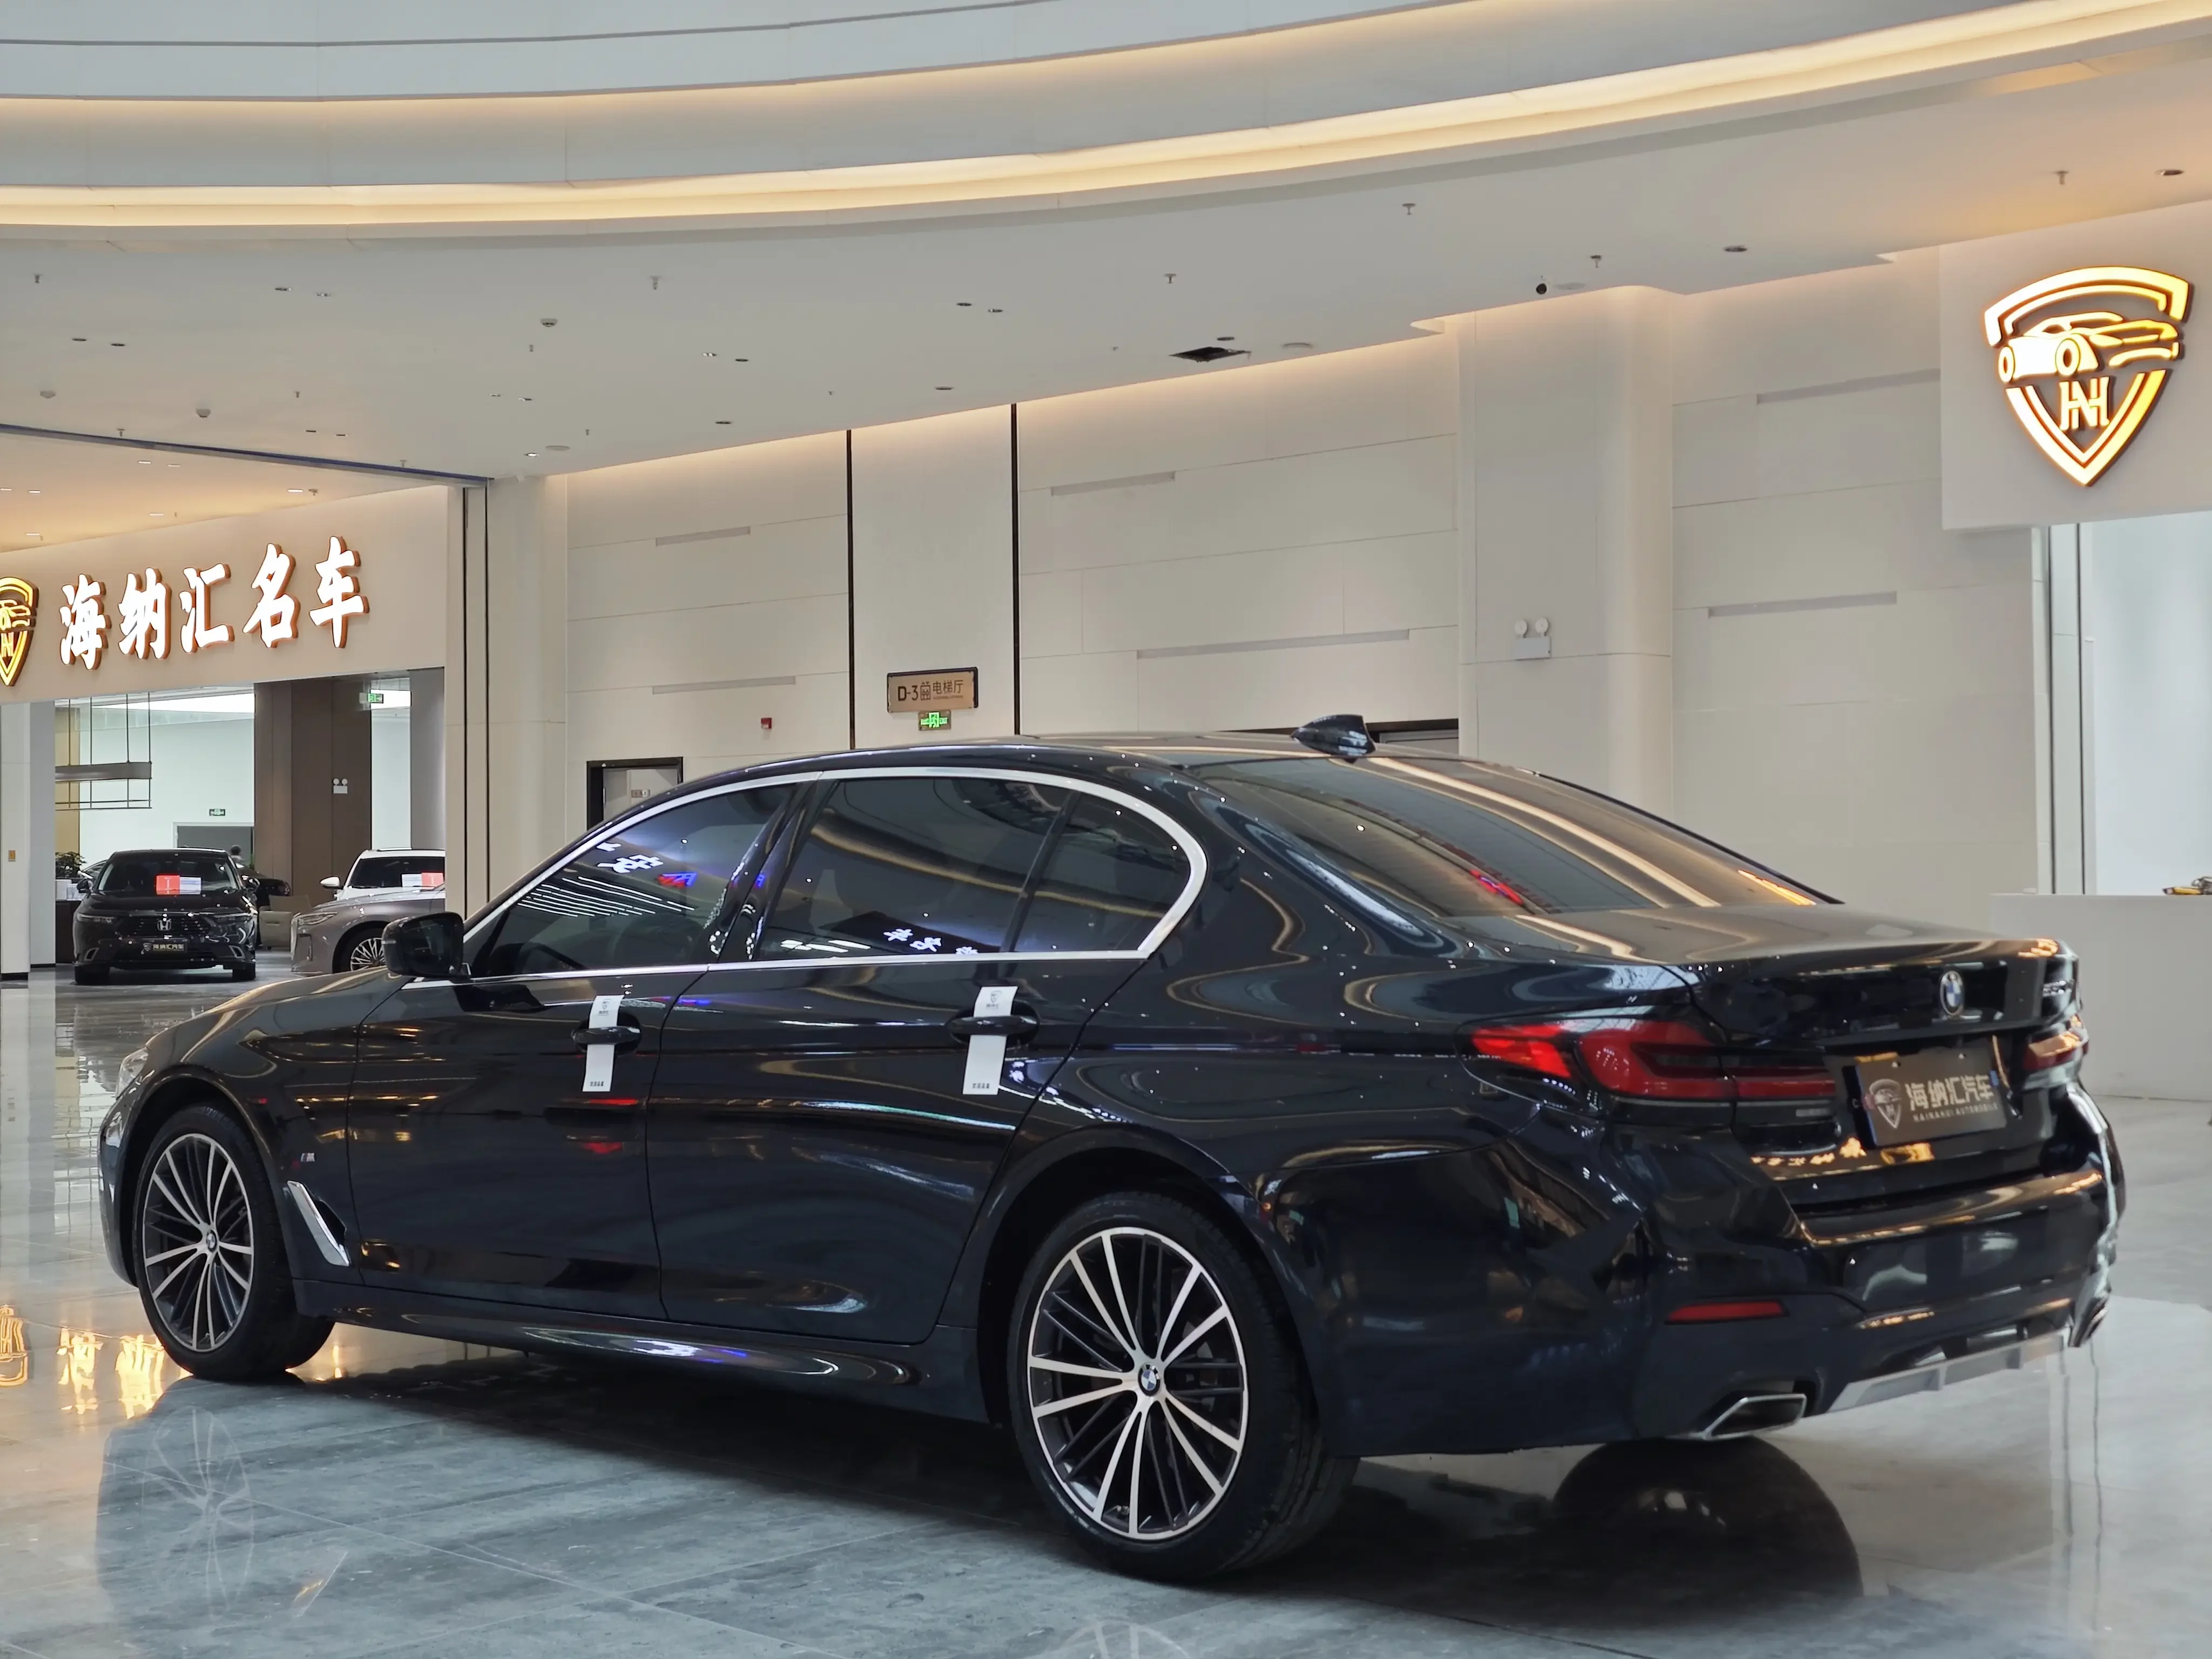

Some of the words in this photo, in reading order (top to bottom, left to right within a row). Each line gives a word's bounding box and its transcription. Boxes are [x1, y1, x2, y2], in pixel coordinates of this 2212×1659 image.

[59, 535, 369, 670] 海纳汇名车
[898, 685, 919, 702] D-3
[933, 679, 964, 694] 电梯厅
[1905, 1074, 1994, 1111] 海纳汇汽车
